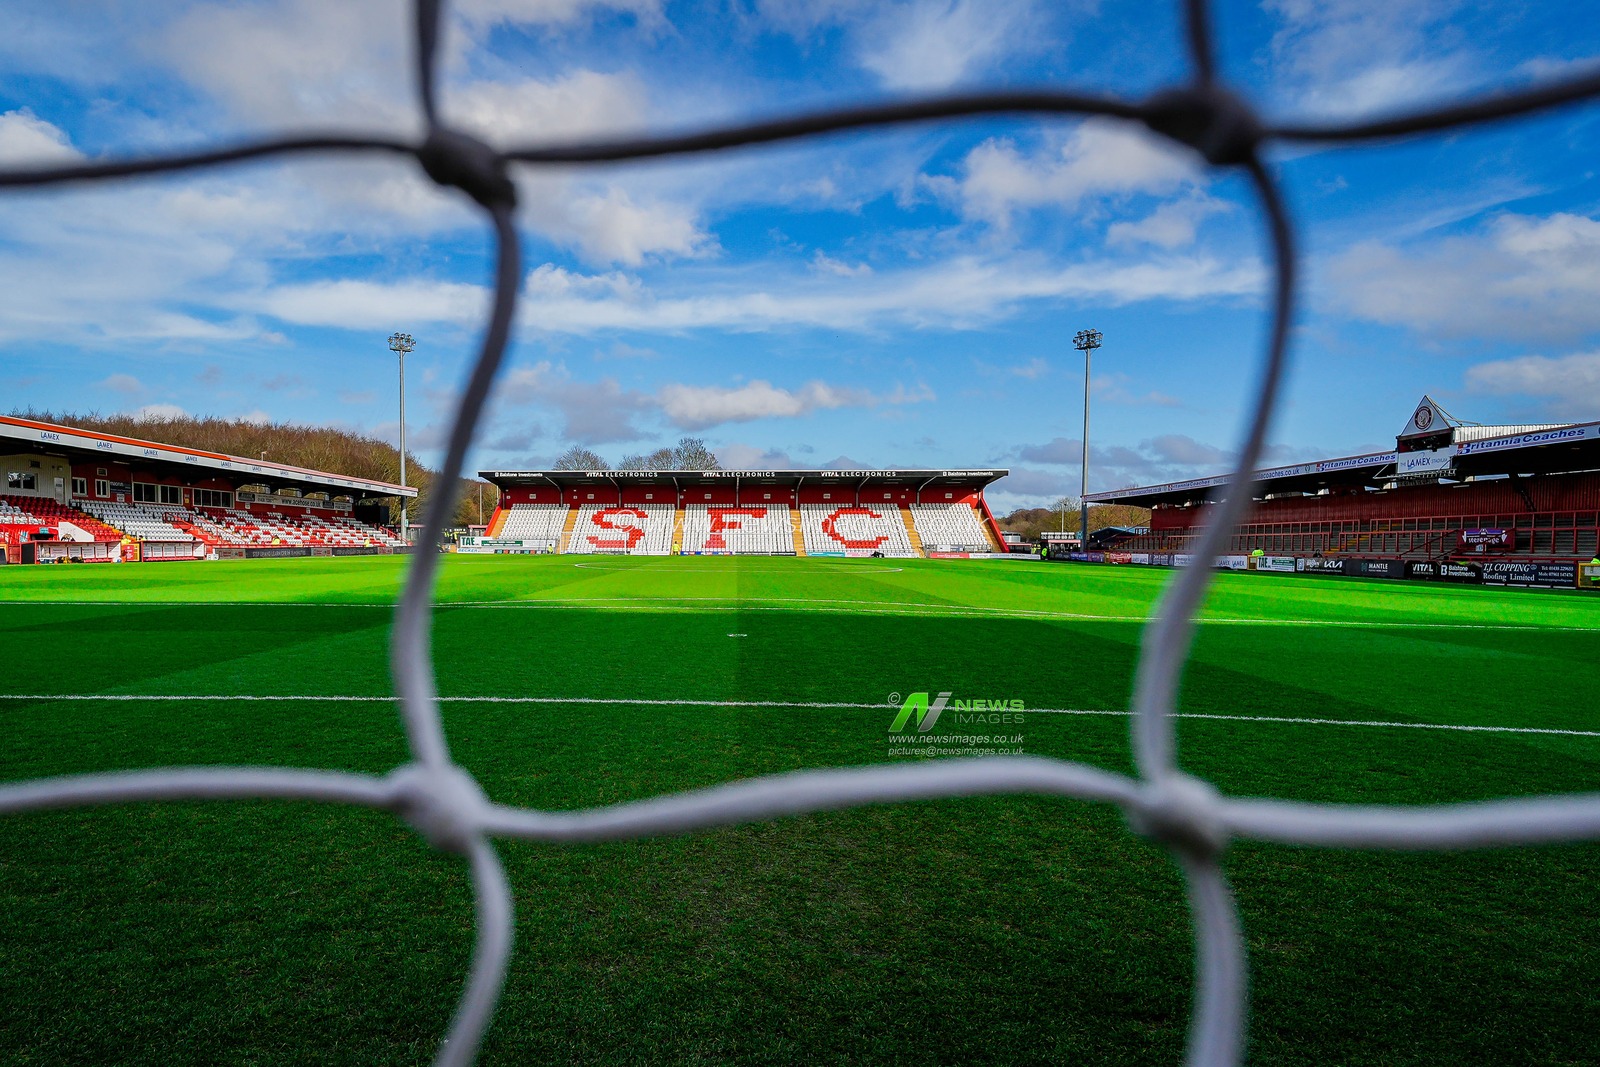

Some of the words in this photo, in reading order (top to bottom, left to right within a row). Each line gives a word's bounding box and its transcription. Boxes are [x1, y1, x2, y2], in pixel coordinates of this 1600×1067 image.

[40, 431, 60, 441] LAMEX
[1522, 428, 1585, 443] Coaches
[96, 440, 113, 449] LAMEX
[1357, 453, 1396, 465] Coaches
[1407, 457, 1431, 470] LAMEX
[1258, 557, 1268, 568] TAE
[1412, 563, 1434, 572] VITAL
[1494, 563, 1530, 573] COPPING
[1483, 572, 1507, 582] Roofing
[1510, 573, 1535, 581] Limited
